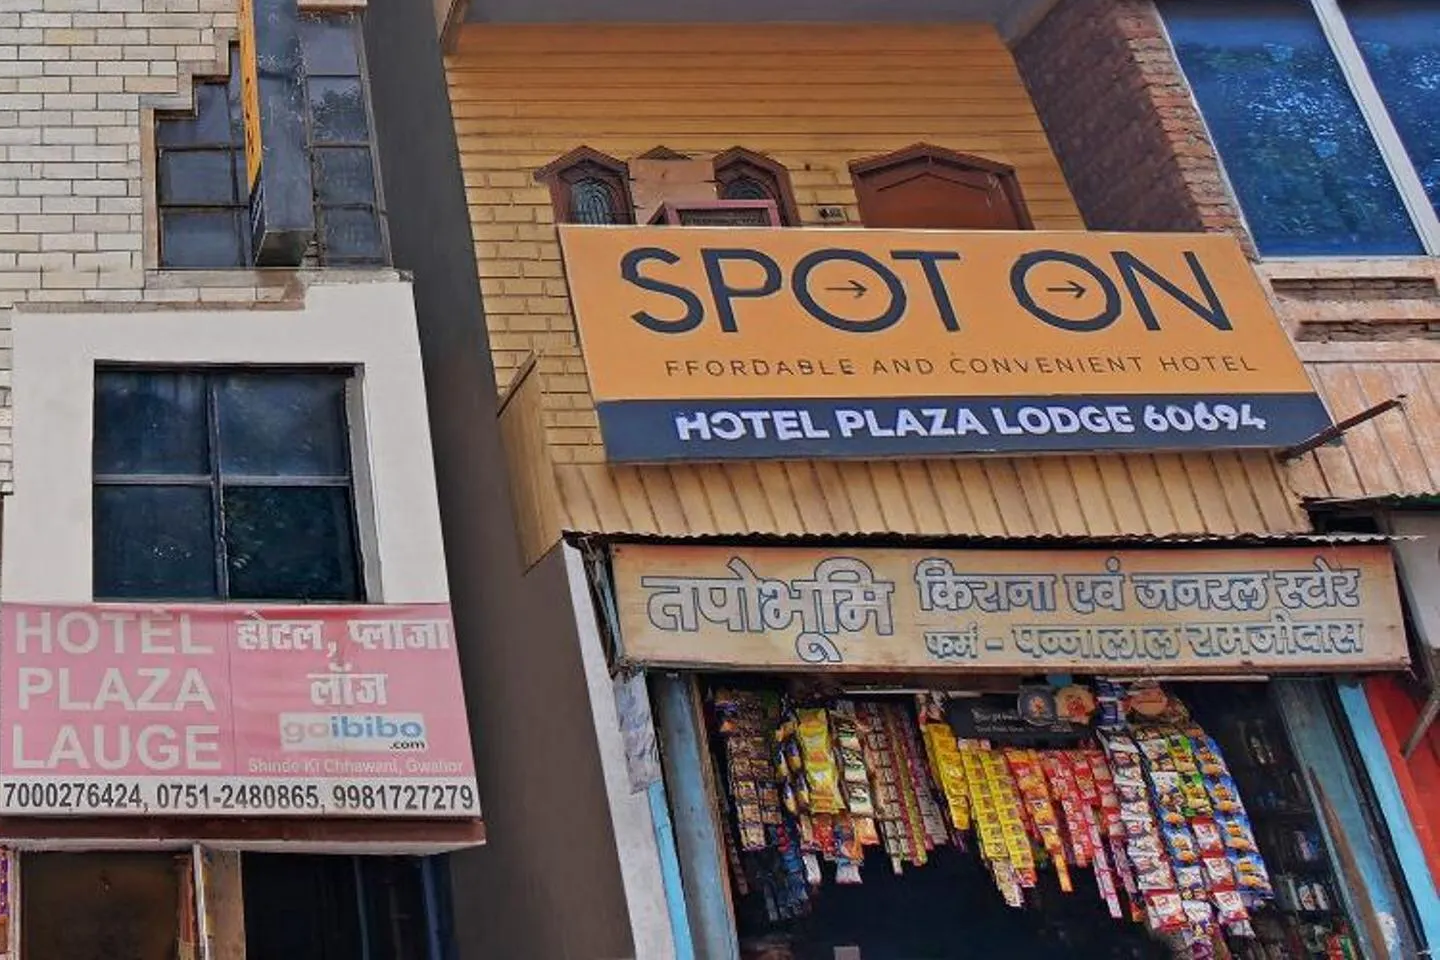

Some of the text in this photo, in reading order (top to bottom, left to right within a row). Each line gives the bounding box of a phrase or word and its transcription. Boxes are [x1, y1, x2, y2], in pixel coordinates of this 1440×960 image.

[620, 247, 1235, 334] SPOT ON
[665, 355, 1260, 377] FFORDABLE AND CONVENIENT HOTEL
[674, 401, 1267, 441] HOTEL PLAZA LODGE 60694
[915, 556, 1360, 614] किराना एवं जनरल स्टोर
[641, 556, 895, 663] तपोभूमि
[15, 610, 215, 655] HOTEL
[347, 619, 452, 651] प्लाजा
[18, 666, 216, 712] PLAZA
[12, 723, 222, 771] LAUGE
[282, 715, 423, 744] goibibo
[4, 783, 474, 814] 7000276424, 0751-2480865, 9981727279
